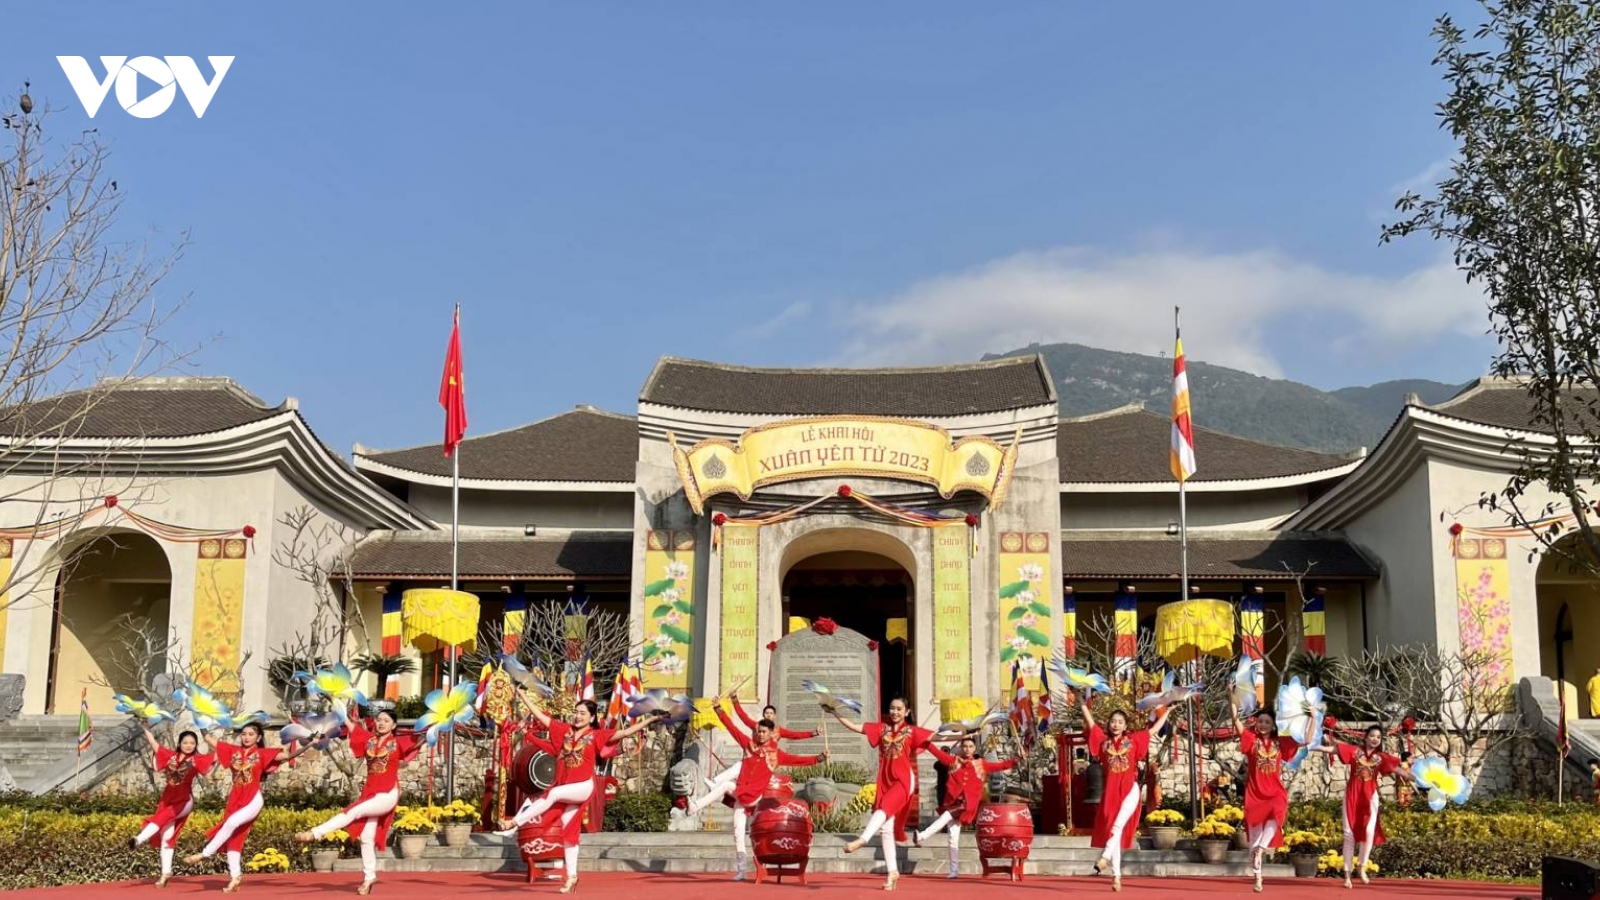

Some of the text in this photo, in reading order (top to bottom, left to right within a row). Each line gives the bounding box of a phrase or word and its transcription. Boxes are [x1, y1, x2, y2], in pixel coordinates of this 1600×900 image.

[818, 427, 848, 440] KHAI
[852, 426, 875, 443] HỘI
[759, 449, 811, 473] XUÂN
[816, 444, 855, 467] YÊN
[889, 450, 930, 472] 2023
